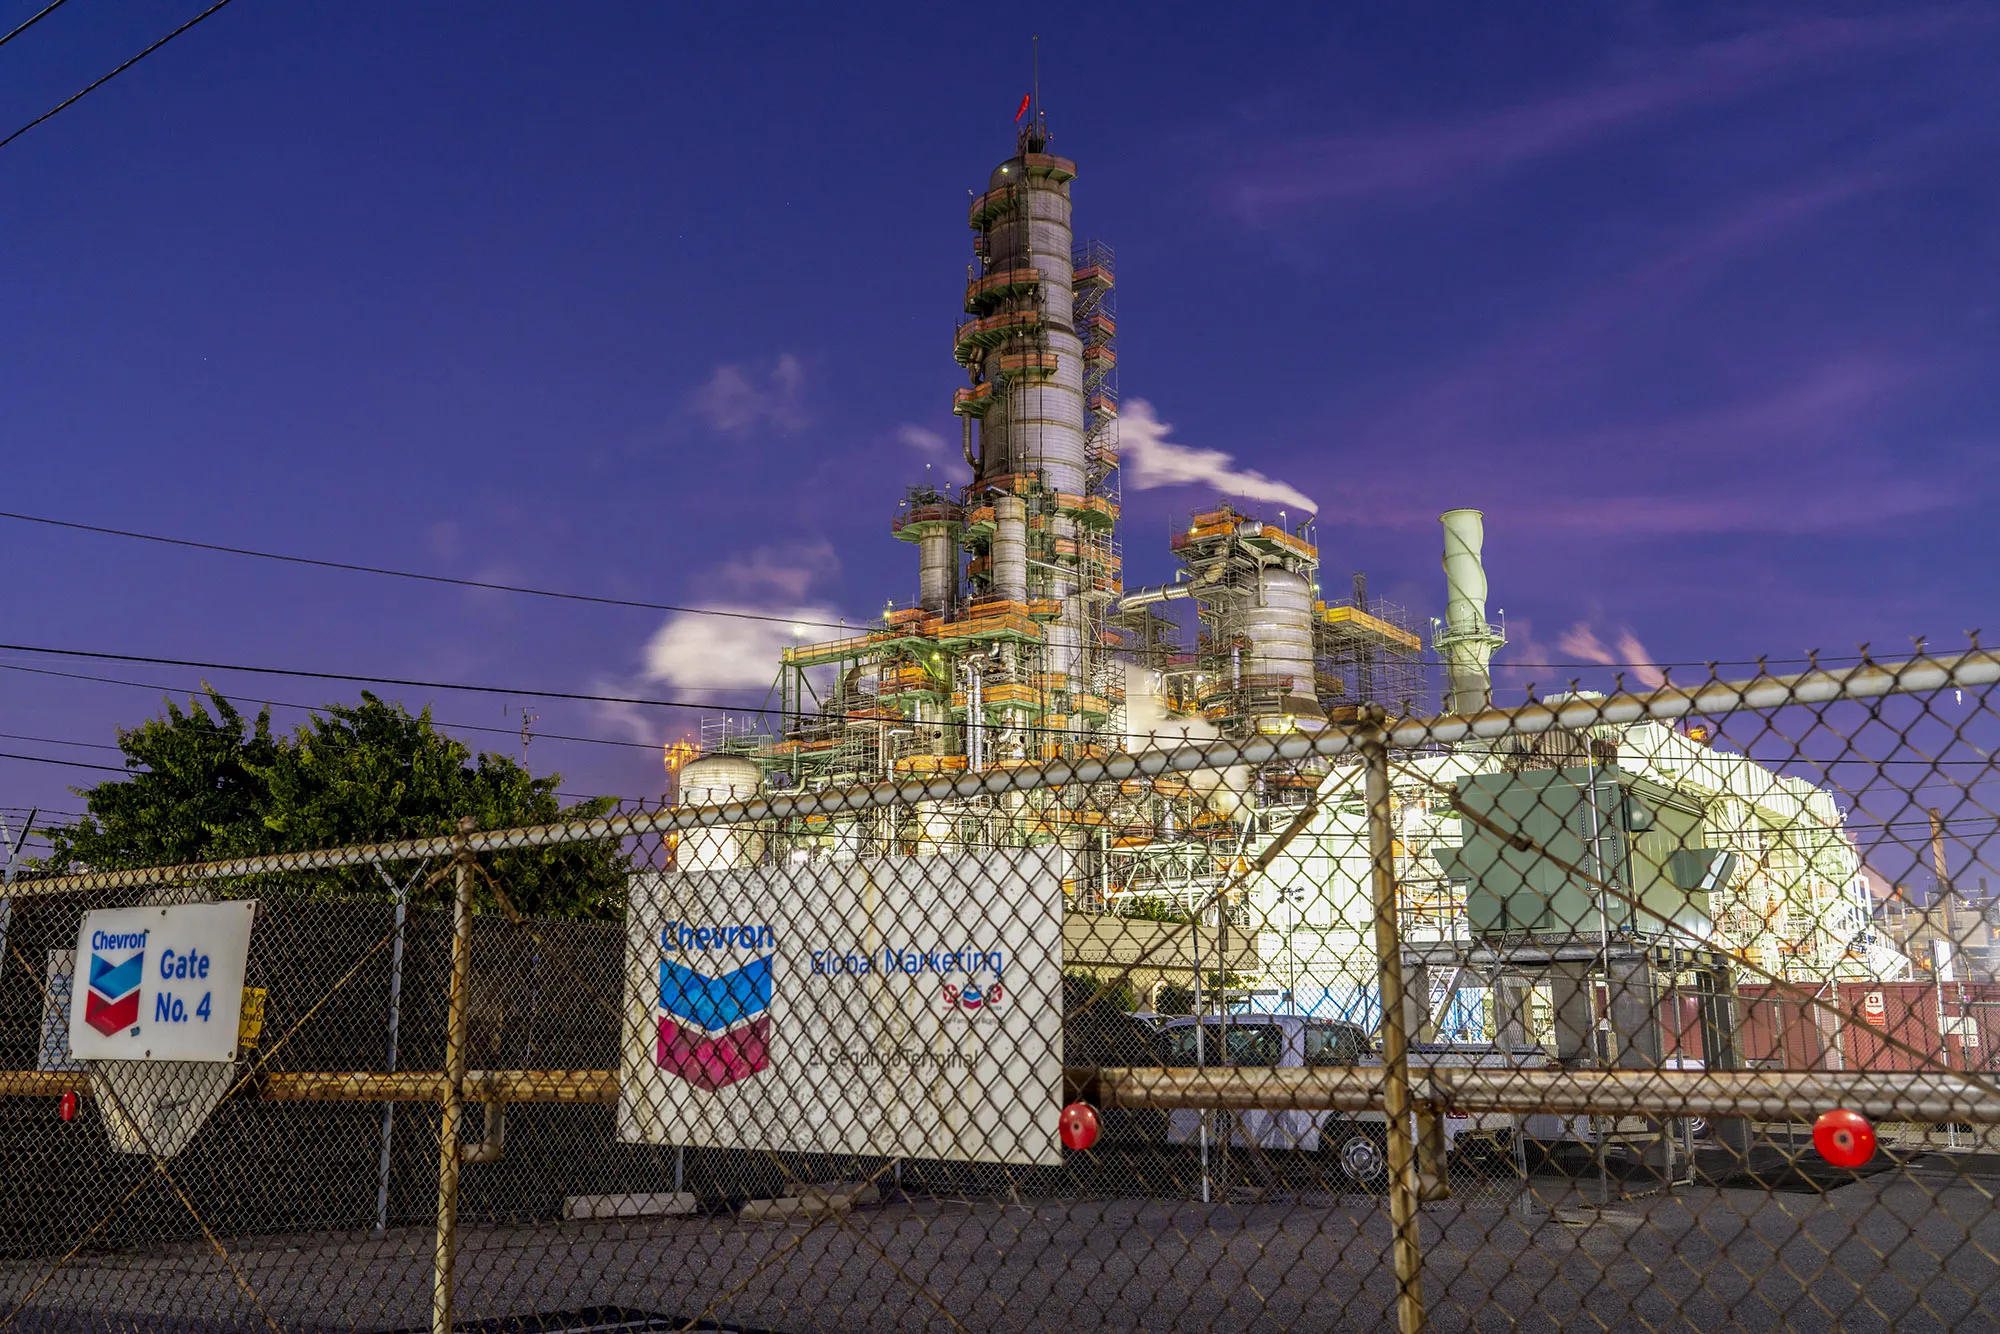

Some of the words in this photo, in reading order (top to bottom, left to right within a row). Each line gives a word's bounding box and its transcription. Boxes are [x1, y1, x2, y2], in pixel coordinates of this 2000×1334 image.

[92, 930, 146, 951] Chevron
[661, 921, 774, 951] Chevron
[161, 948, 210, 979] Gate
[811, 948, 877, 975] Global
[885, 946, 1002, 979] Marketing
[155, 992, 188, 1022] No.
[196, 992, 212, 1022] 4
[829, 1048, 901, 1069] Segundo
[902, 1048, 979, 1069] Terminal
